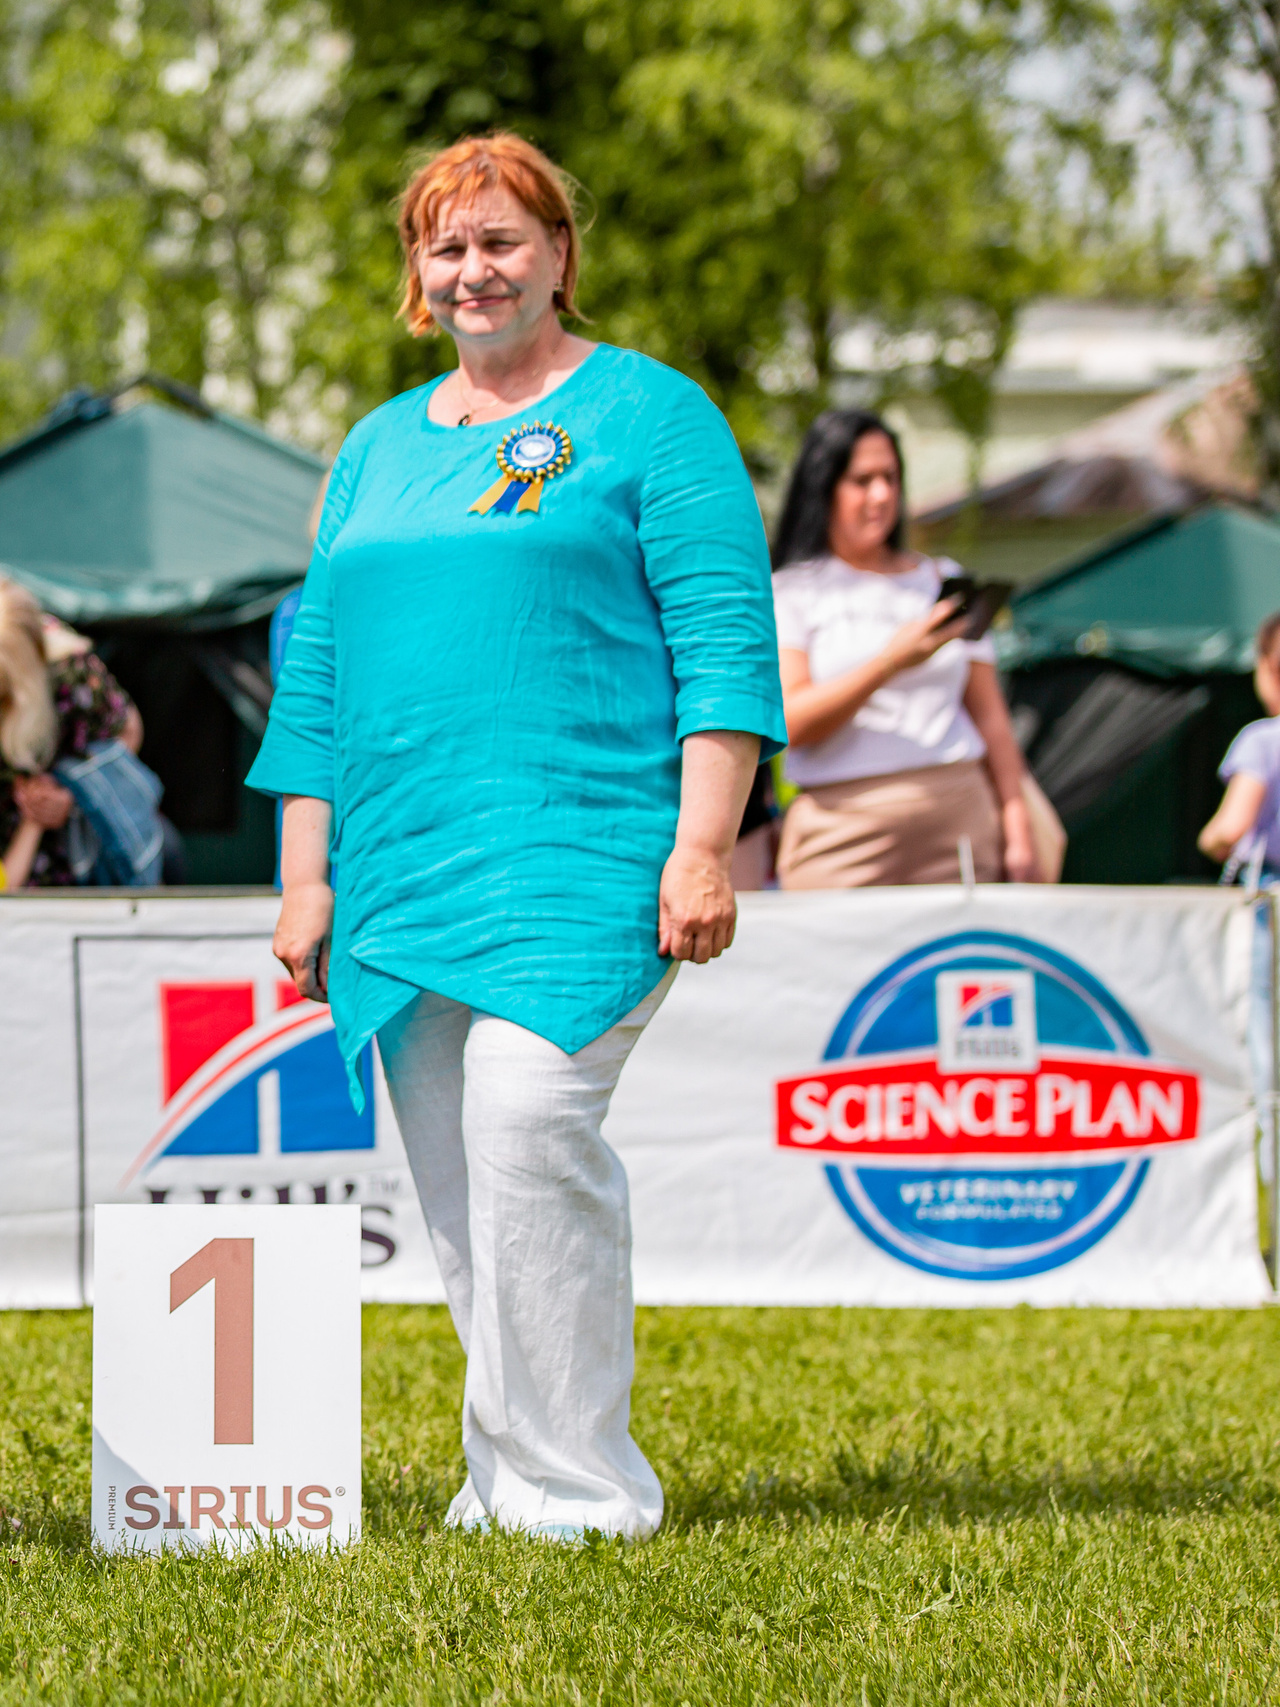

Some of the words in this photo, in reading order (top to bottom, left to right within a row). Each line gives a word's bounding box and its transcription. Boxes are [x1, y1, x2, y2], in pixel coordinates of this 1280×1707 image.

[789, 1080, 1028, 1143] SCIENCE
[1035, 1073, 1184, 1138] PLAN
[170, 1237, 254, 1445] 1
[108, 1485, 116, 1530] PREMIUM
